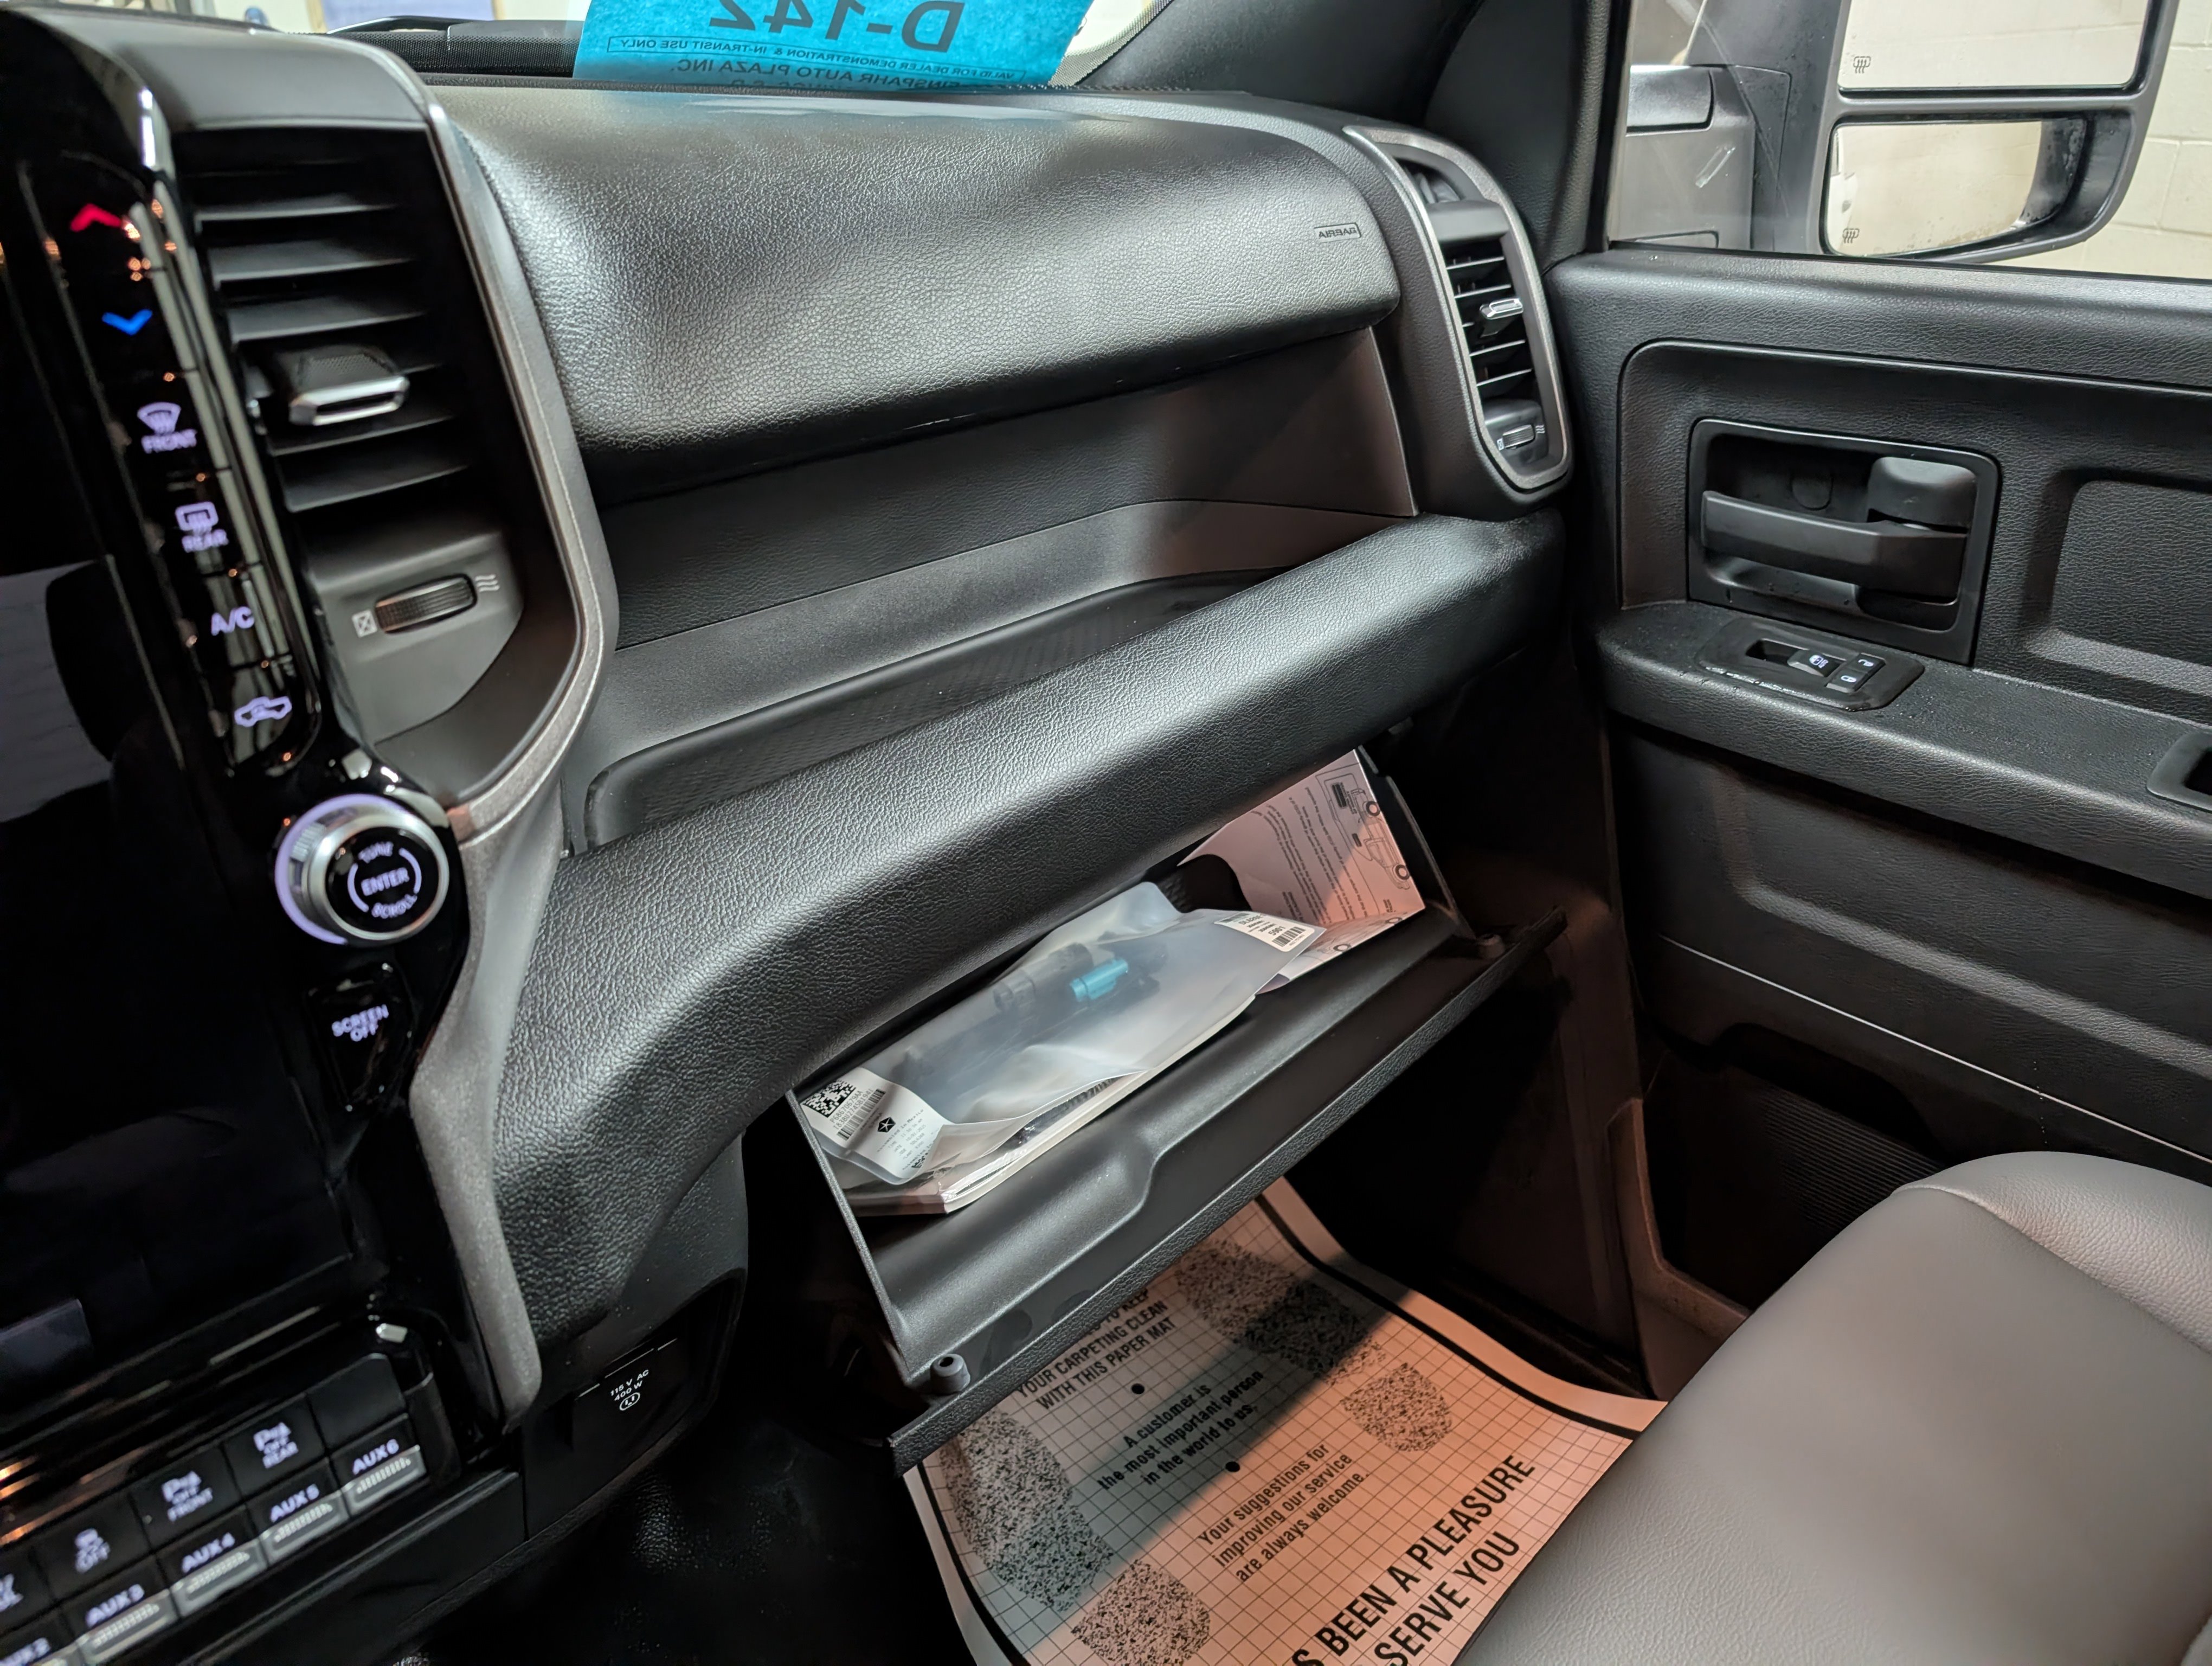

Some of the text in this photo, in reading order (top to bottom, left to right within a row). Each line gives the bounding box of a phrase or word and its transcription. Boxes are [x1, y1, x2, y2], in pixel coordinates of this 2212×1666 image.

[1319, 227, 1357, 239] AIRBAG
[209, 605, 253, 635] A/C
[362, 868, 408, 895] ENTER
[372, 893, 417, 920] SCROLL
[334, 1005, 386, 1035] SCREEN
[349, 1021, 380, 1043] OFF
[829, 1089, 863, 1123] P68670679AA
[1017, 1299, 1168, 1399] YOUR CARPETING CLEAN
[1037, 1315, 1176, 1410] WITH THIS PAPER MAT
[610, 1384, 624, 1395] 115
[635, 1369, 649, 1380] AC
[614, 1380, 644, 1400] 400 W
[1097, 1369, 1264, 1491] the most important person
[1123, 1381, 1212, 1449] A customer is
[262, 1440, 298, 1469] REAR
[1141, 1468, 1161, 1486] in
[1156, 1451, 1184, 1475] the
[1180, 1425, 1221, 1459] world
[1218, 1414, 1236, 1432] to
[169, 1488, 214, 1522] FRONT
[1198, 1442, 1329, 1547] Your suggestions for
[1212, 1451, 1352, 1569] improving our service
[1234, 1471, 1370, 1582] are always welcome.
[1316, 1584, 1397, 1656] BEEN
[1386, 1560, 1419, 1594] A
[1407, 1456, 1533, 1570] PLEASURE
[1373, 1531, 1520, 1666] SERVE YOU
